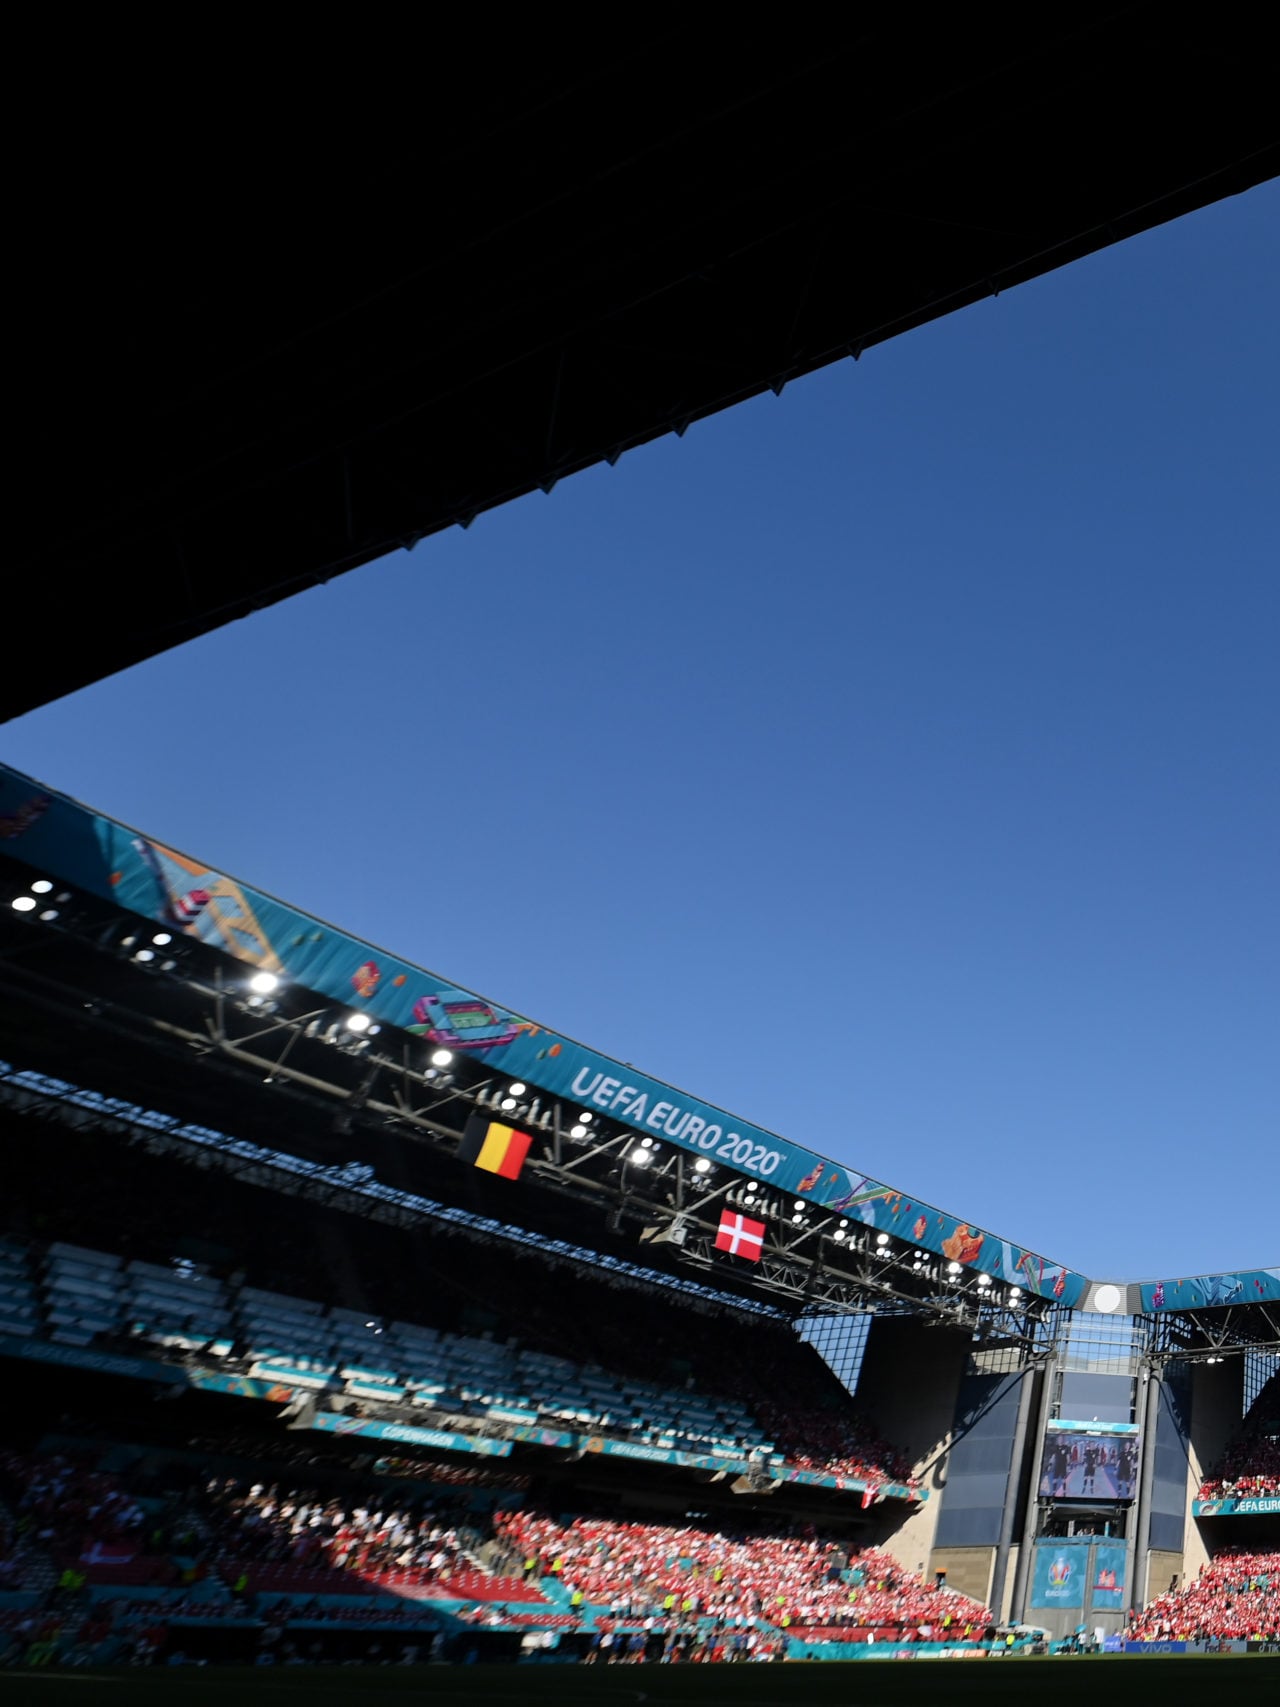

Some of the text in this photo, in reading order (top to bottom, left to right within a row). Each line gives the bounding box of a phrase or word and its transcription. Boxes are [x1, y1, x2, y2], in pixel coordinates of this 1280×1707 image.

[571, 1066, 649, 1121] UEFA
[646, 1101, 722, 1150] EURO
[716, 1133, 780, 1175] 2020
[1139, 1642, 1172, 1653] vivo
[1204, 1642, 1232, 1654] FedEx
